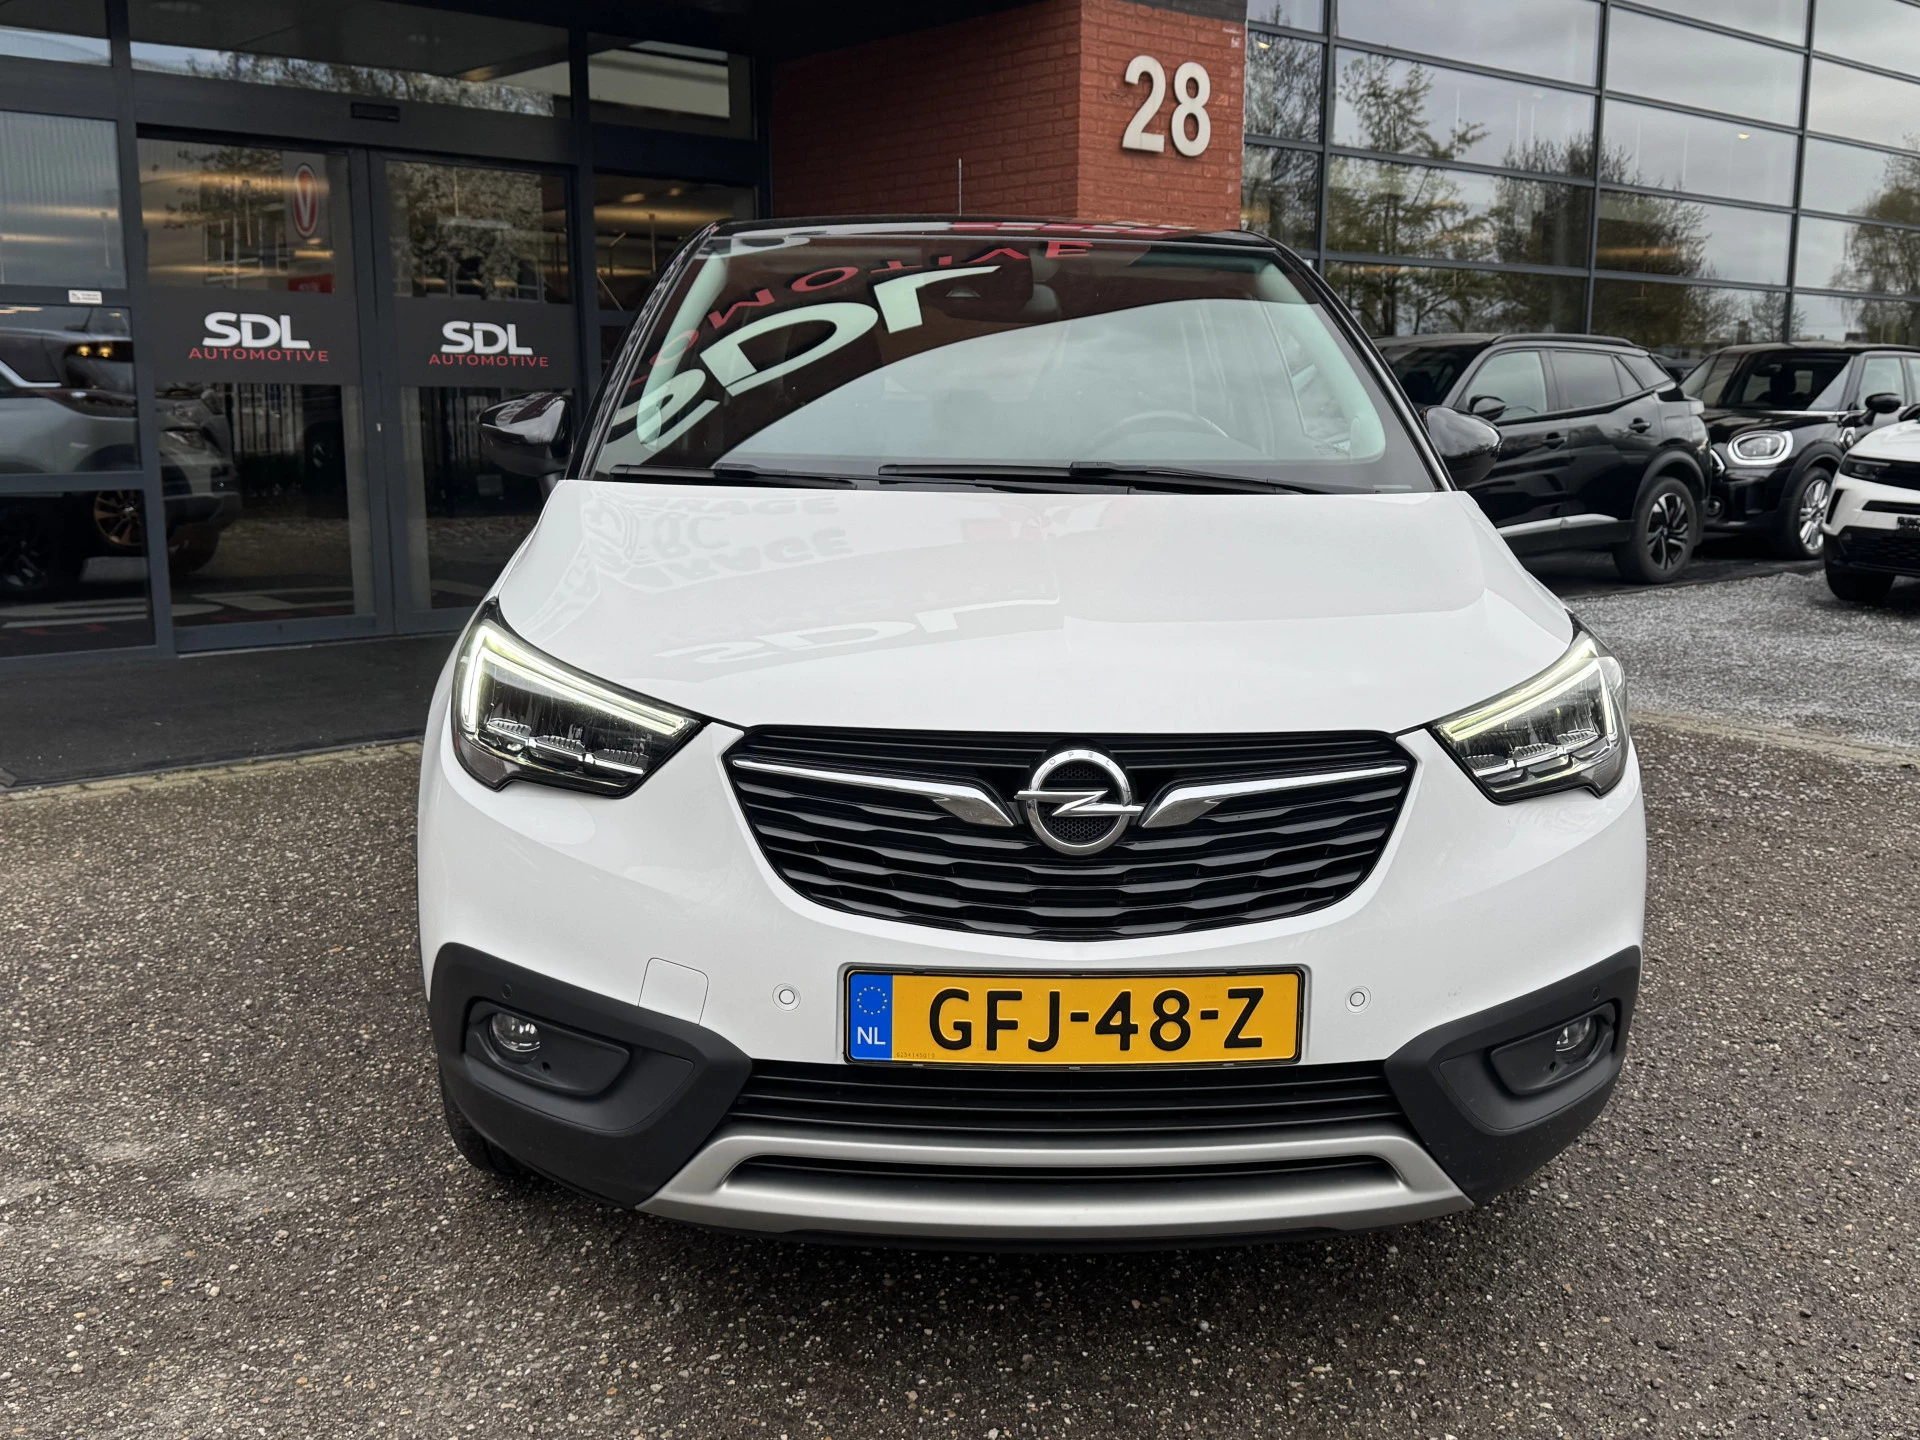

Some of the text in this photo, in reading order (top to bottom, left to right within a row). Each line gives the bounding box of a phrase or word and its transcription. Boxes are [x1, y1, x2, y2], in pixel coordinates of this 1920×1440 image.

[1122, 55, 1211, 157] 28
[203, 311, 311, 349] SDL
[440, 320, 534, 355] SDL
[188, 347, 329, 362] AUTOMOTIVE
[428, 354, 549, 368] AUTOMOTIVE
[1048, 750, 1110, 767] OPEL
[929, 987, 1265, 1053] GFJ-48-Z
[856, 1026, 886, 1046] NL
